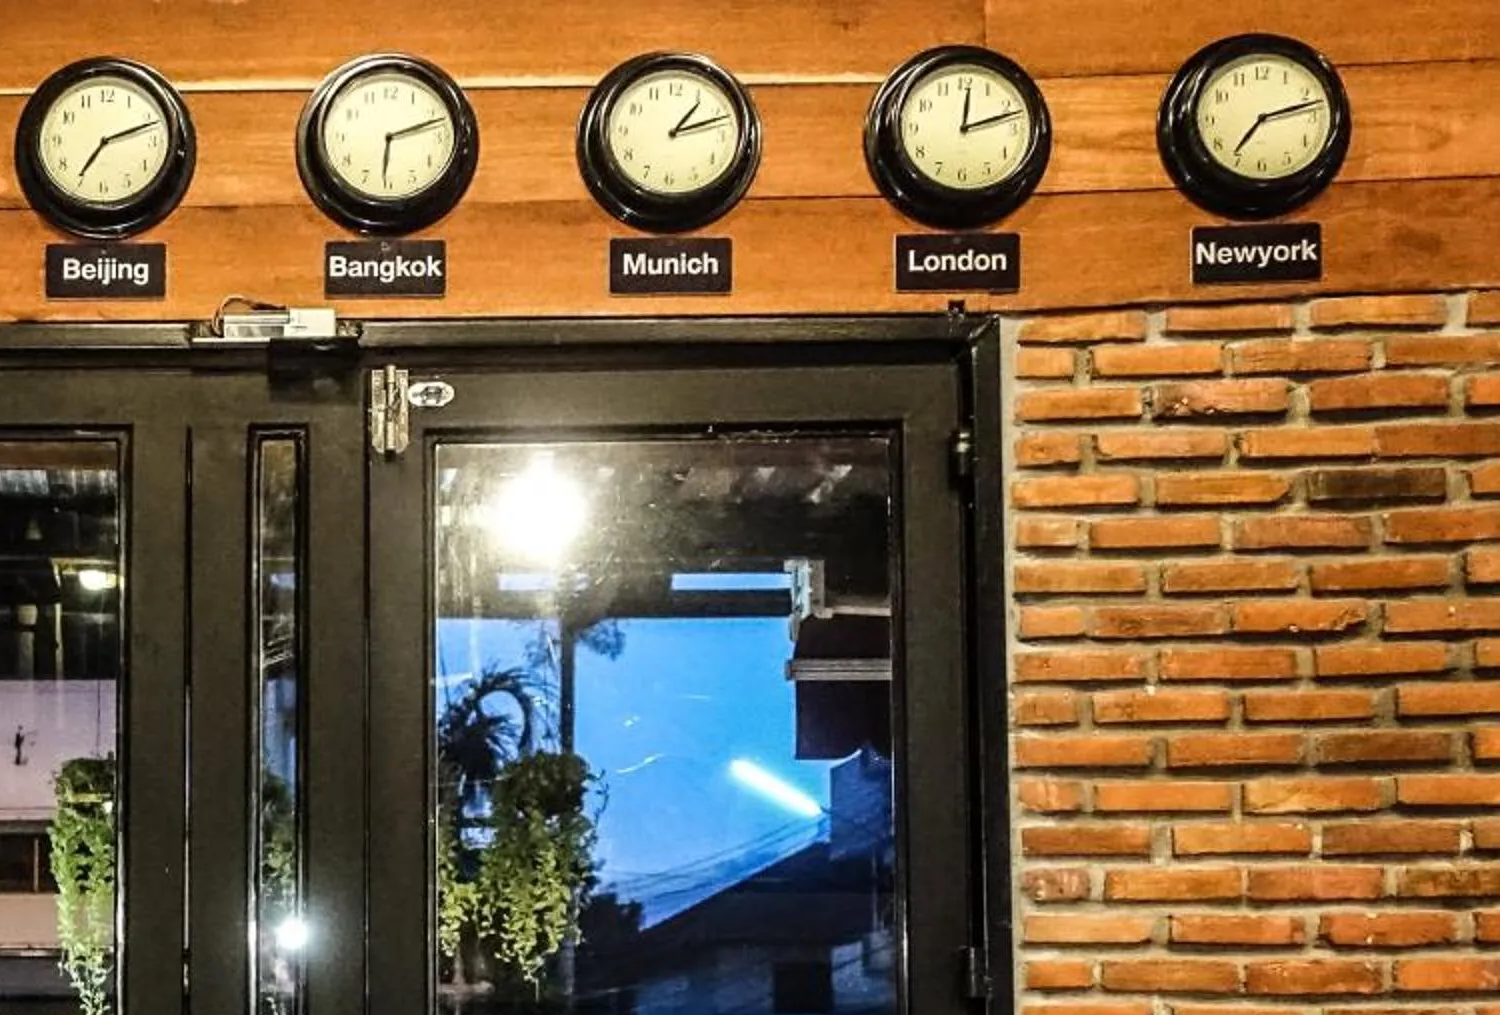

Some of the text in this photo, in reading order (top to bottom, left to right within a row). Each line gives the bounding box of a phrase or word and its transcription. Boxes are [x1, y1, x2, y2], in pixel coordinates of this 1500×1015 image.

[622, 252, 719, 276] Munich
[908, 250, 1008, 273] London
[1195, 239, 1318, 268] Newyork
[63, 258, 150, 285] Beijing
[329, 255, 442, 281] Bangkok
